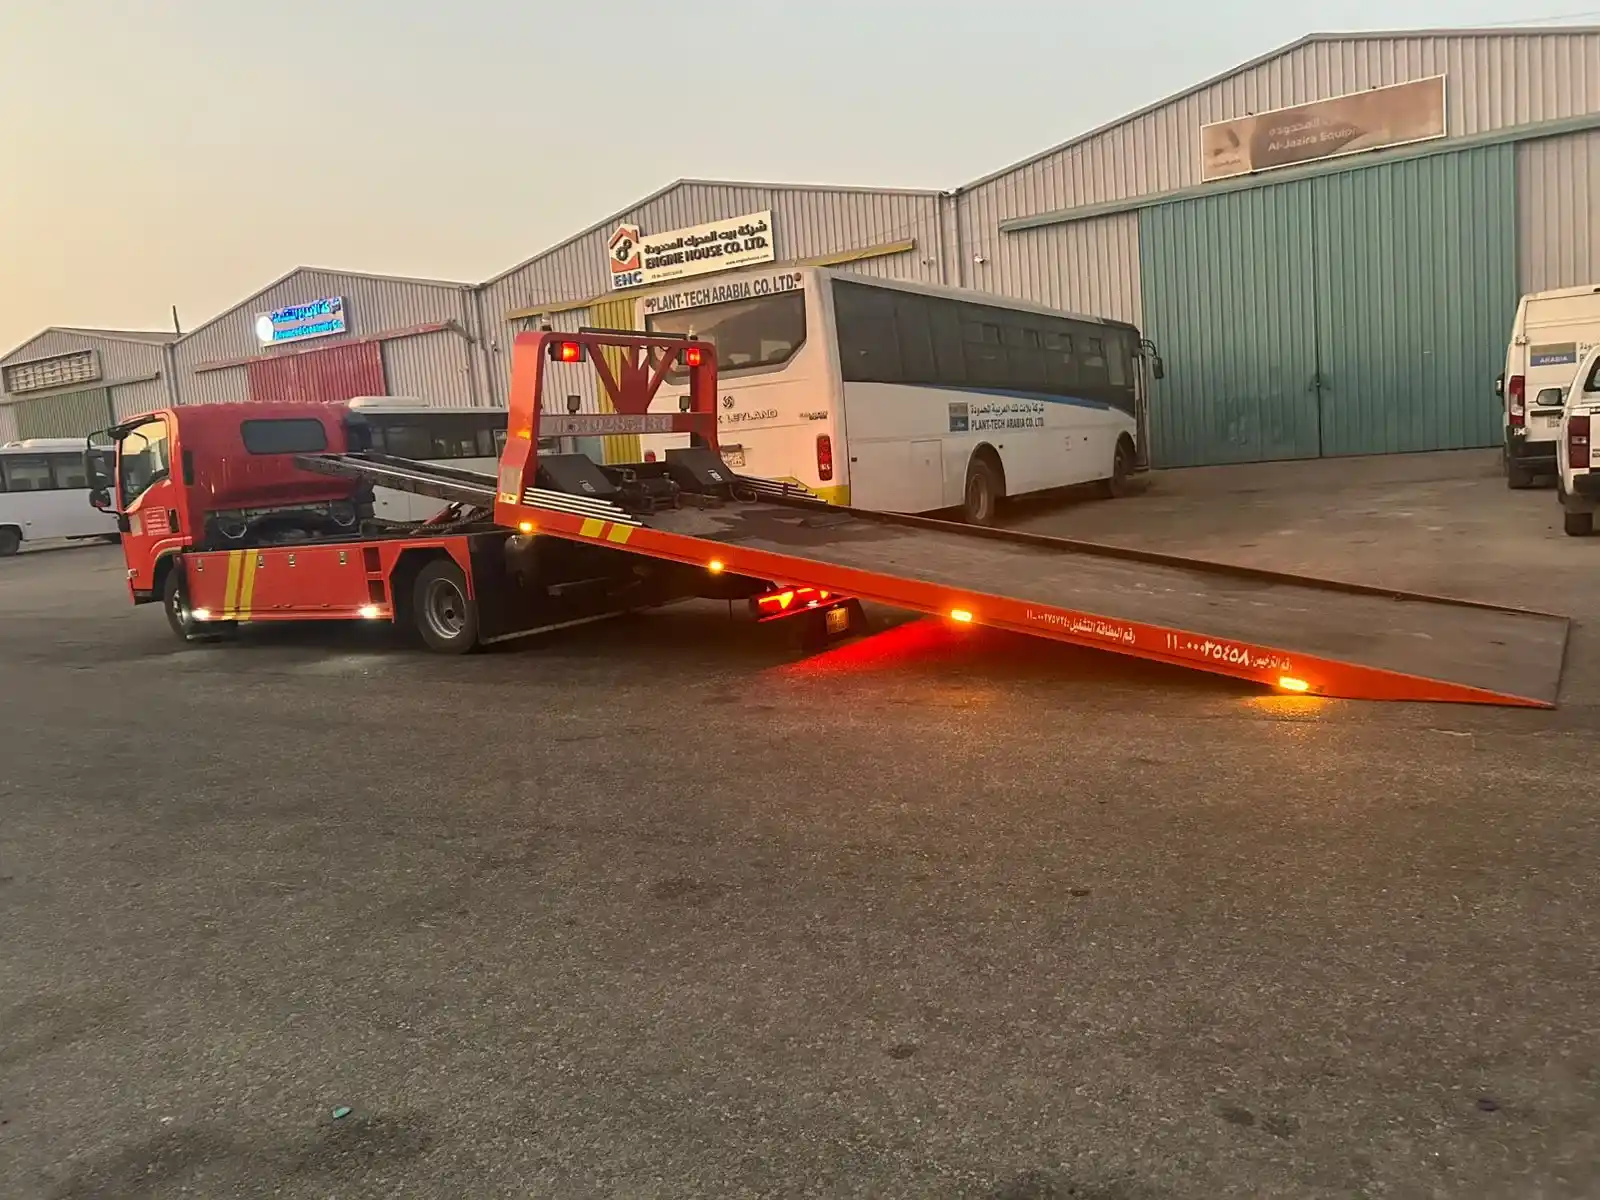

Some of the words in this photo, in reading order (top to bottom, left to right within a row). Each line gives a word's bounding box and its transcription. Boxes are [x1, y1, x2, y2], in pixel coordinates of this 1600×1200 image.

[1267, 136, 1317, 152] Al-Jazira
[645, 252, 685, 270] ENGINE
[685, 244, 723, 262] HOUSE
[723, 240, 743, 255] CO.
[744, 235, 769, 250] LTD.
[613, 270, 644, 288] EHC
[651, 292, 710, 313] PLANT-TECH
[711, 280, 752, 303] ARABIA
[753, 278, 772, 295] CO.
[773, 273, 798, 292] LTD.
[727, 409, 778, 424] LEYLAND
[970, 418, 1006, 432] PLANT-TECH
